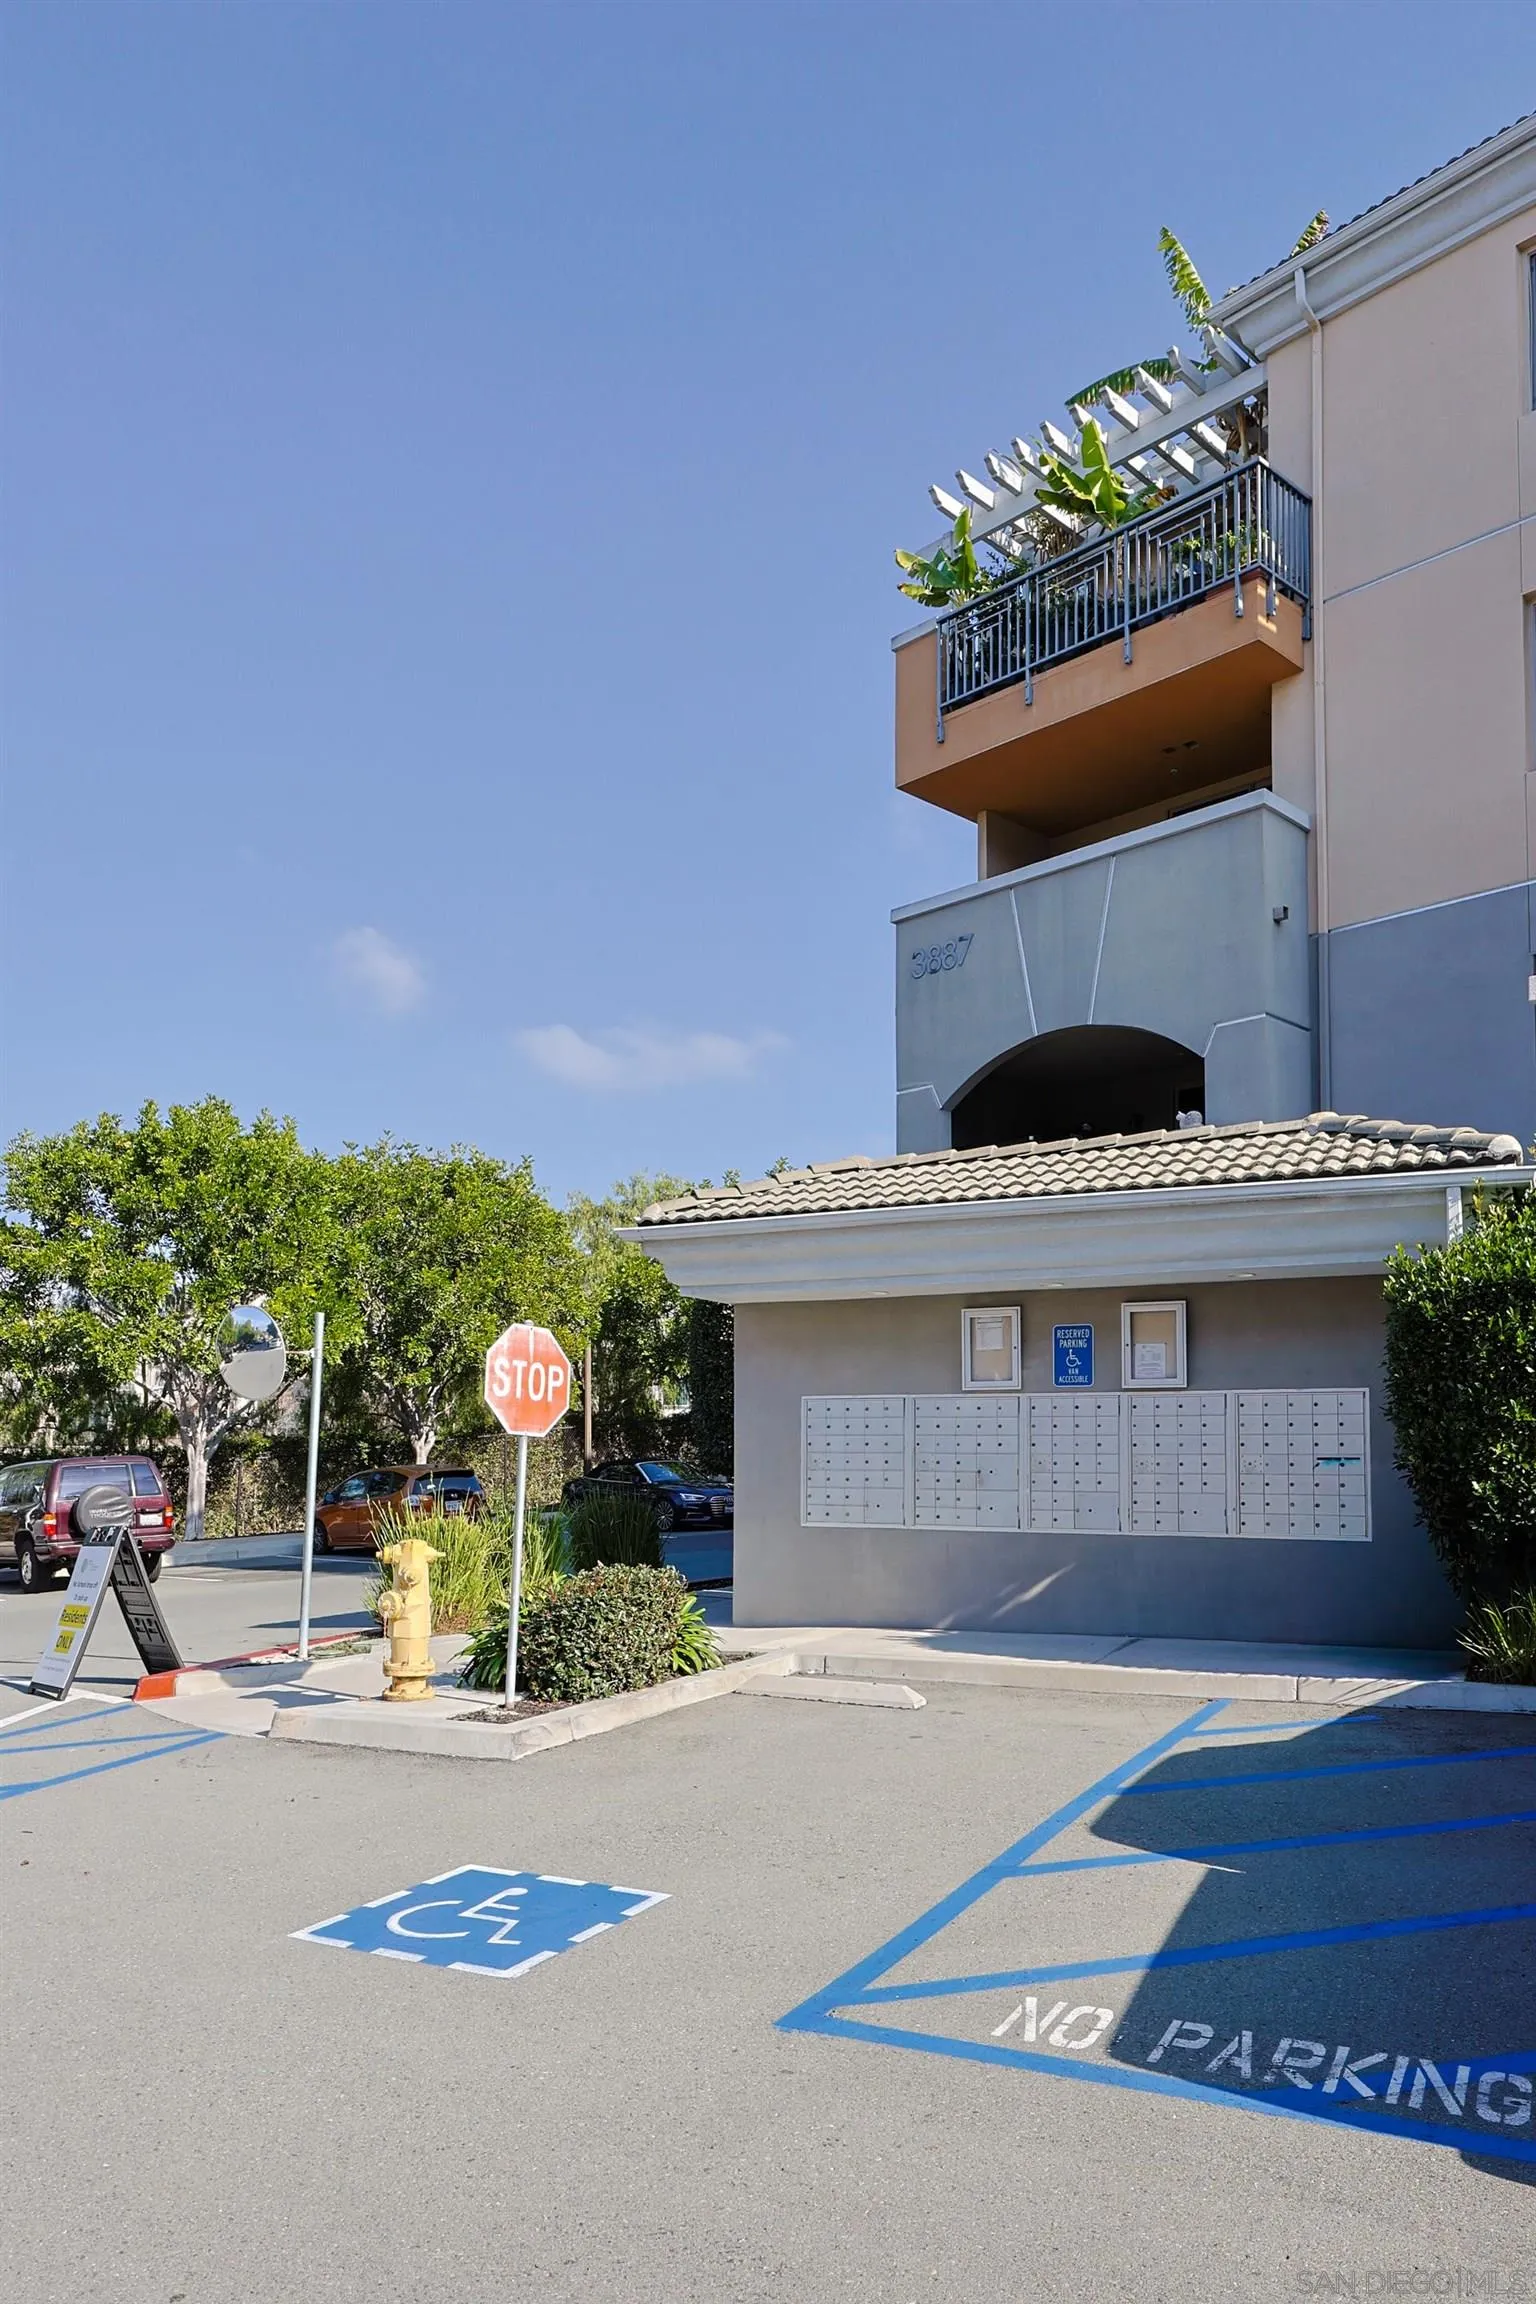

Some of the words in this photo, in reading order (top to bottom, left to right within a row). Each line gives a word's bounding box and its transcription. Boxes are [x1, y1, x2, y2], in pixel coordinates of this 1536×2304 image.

[911, 932, 975, 980] 3887
[1057, 1328, 1090, 1338] RESERVED
[1059, 1338, 1088, 1349] PARKING
[492, 1356, 565, 1403] STOP
[1058, 1375, 1089, 1384] ACCESSIBLE
[56, 1635, 73, 1648] ONLY
[991, 1996, 1115, 2050] NO
[1147, 2019, 1533, 2127] PARKING
